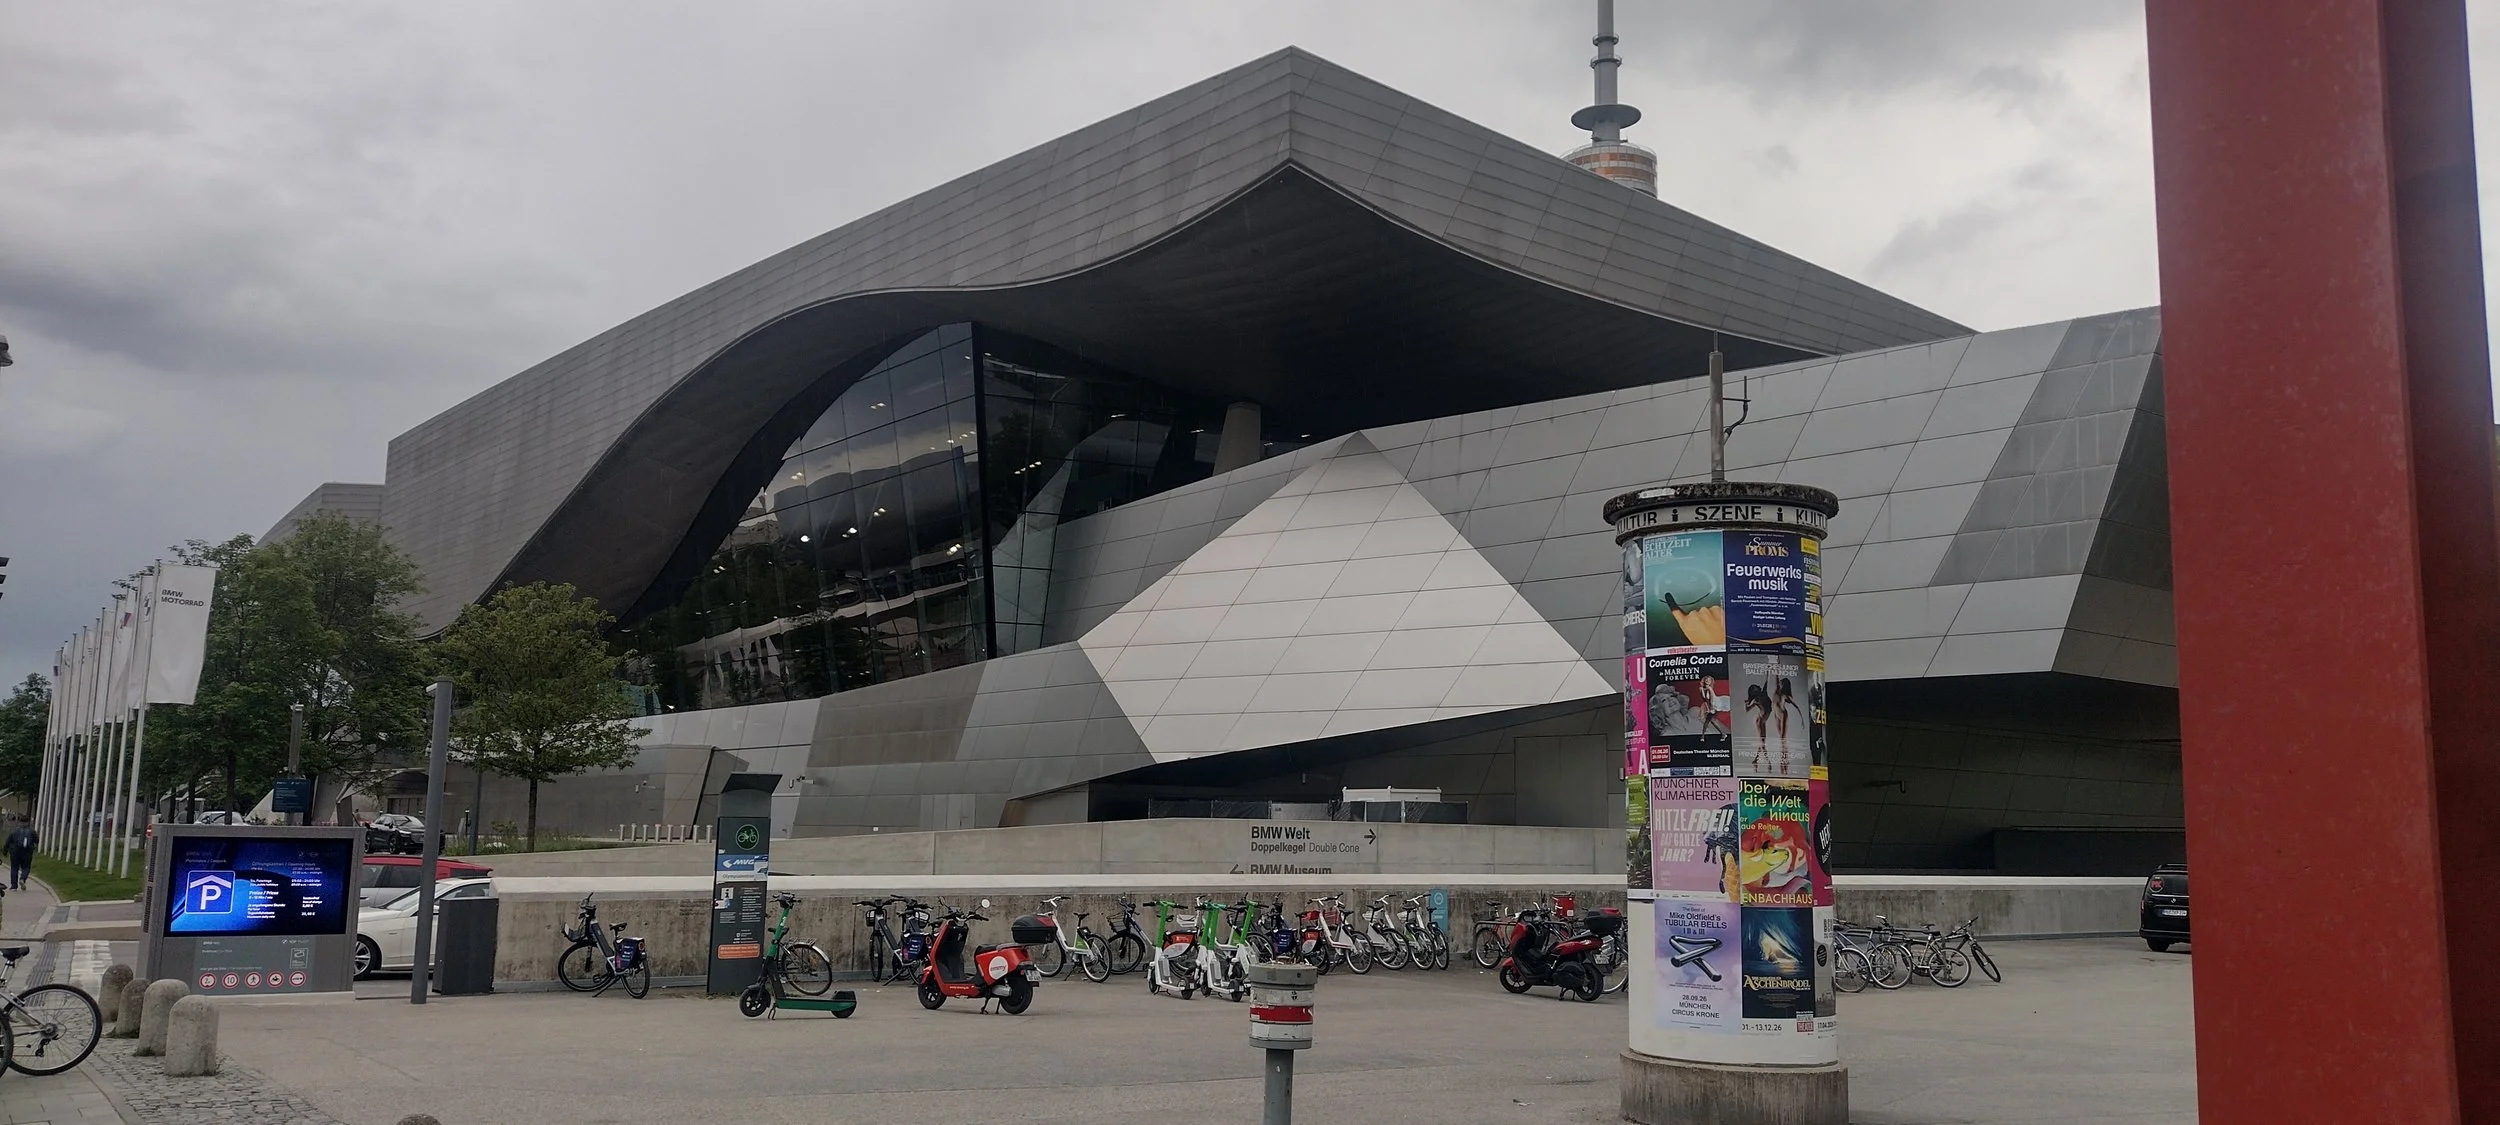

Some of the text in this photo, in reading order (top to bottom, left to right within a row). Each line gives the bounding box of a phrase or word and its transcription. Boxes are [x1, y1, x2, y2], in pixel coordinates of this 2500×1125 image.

[1616, 511, 1658, 534] KULTUR
[1694, 505, 1762, 522] SZENE
[1645, 538, 1692, 552] ECHTZEIT
[1744, 544, 1790, 557] PROMS
[1645, 549, 1673, 560] ALTER
[1727, 563, 1802, 580] Feuerwerks
[1748, 577, 1789, 592] musik
[161, 589, 184, 598] BMW
[161, 596, 205, 607] MOTORRAD
[1649, 654, 1724, 669] Cornelia Corba
[1664, 666, 1700, 677] MARILYN
[1665, 673, 1701, 682] FOREVER
[1654, 790, 1735, 801] KLIMAHERBST
[1743, 793, 1801, 809] die Welt
[1769, 808, 1810, 822] hinaus
[1251, 826, 1310, 840] BMW Welt
[1673, 832, 1701, 847] GANZE
[1251, 841, 1360, 855] Doppelkegel Double Cone
[1660, 847, 1695, 863] JAHR?
[1250, 864, 1332, 874] BMW Museum
[1669, 911, 1721, 922] Mike Oldfield's
[1665, 918, 1728, 930] TUBULAR BELLS
[227, 974, 236, 985] 10
[1682, 994, 1708, 1003] 28.09.26
[1679, 1001, 1712, 1010] MÜNCHEN
[1671, 1008, 1721, 1019] CIRCUS KRONE
